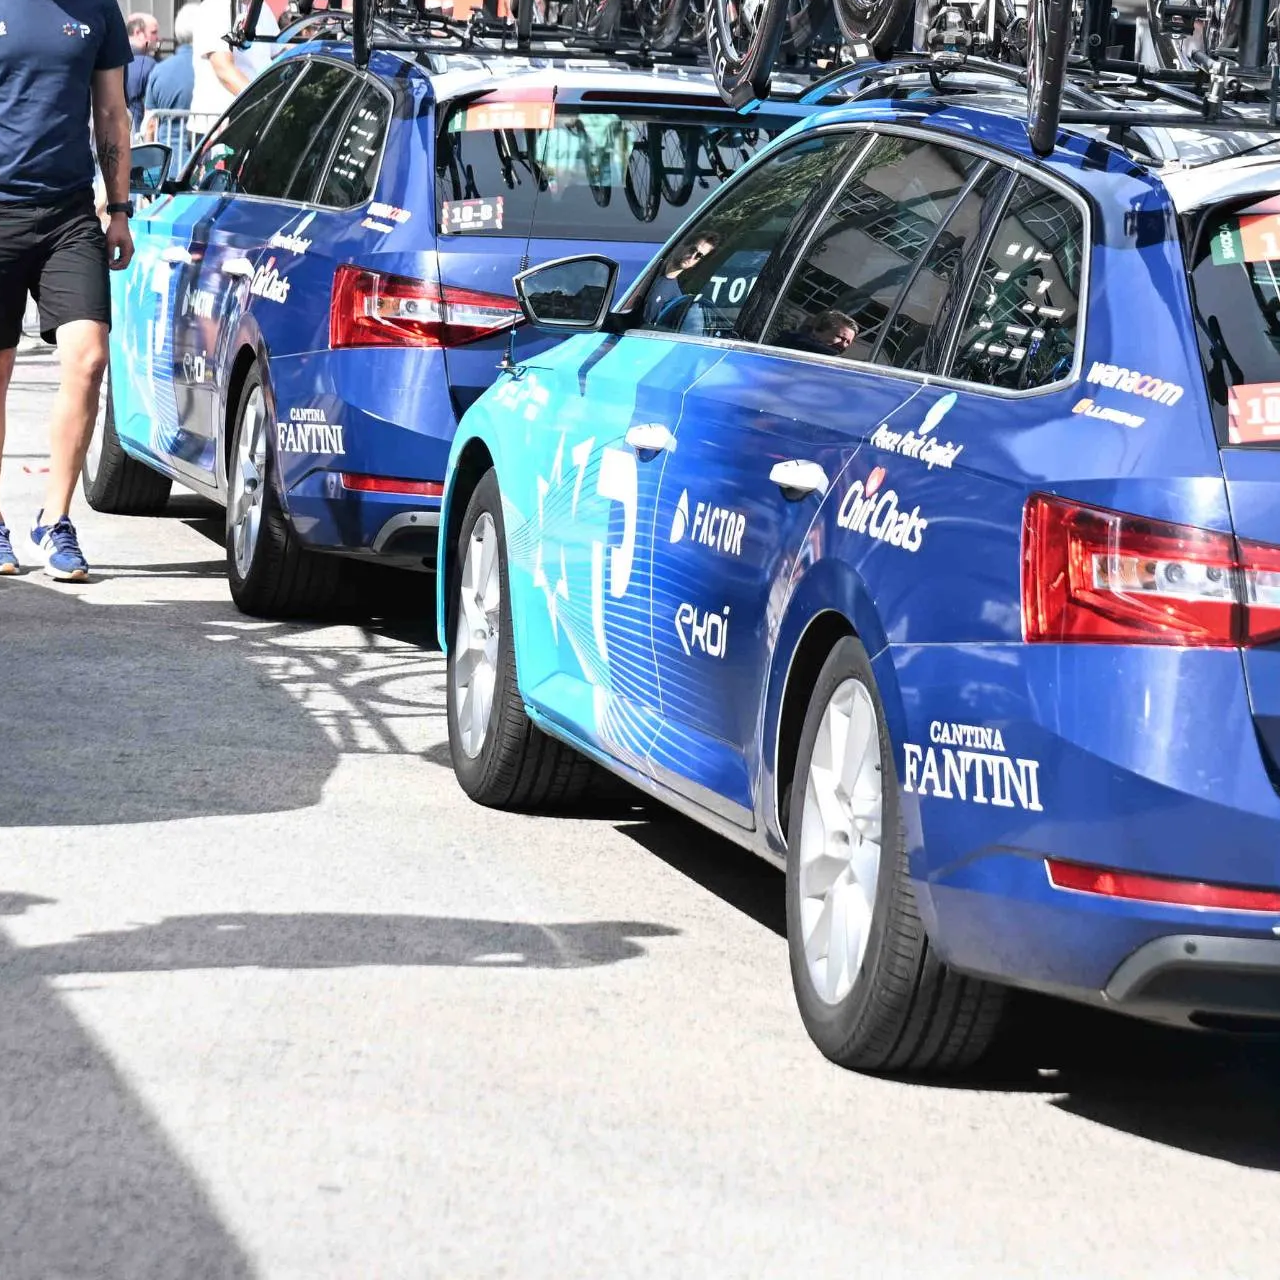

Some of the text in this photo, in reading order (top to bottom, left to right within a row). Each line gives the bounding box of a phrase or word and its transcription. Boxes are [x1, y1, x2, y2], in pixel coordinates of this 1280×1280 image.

[1086, 361, 1185, 407] wanacom
[290, 407, 326, 422] CANTINA
[277, 423, 346, 455] FANTINI
[691, 500, 746, 556] FACTOR
[836, 479, 928, 553] ChitChats
[929, 720, 1006, 752] CANTINA
[902, 743, 1044, 812] FANTINI
